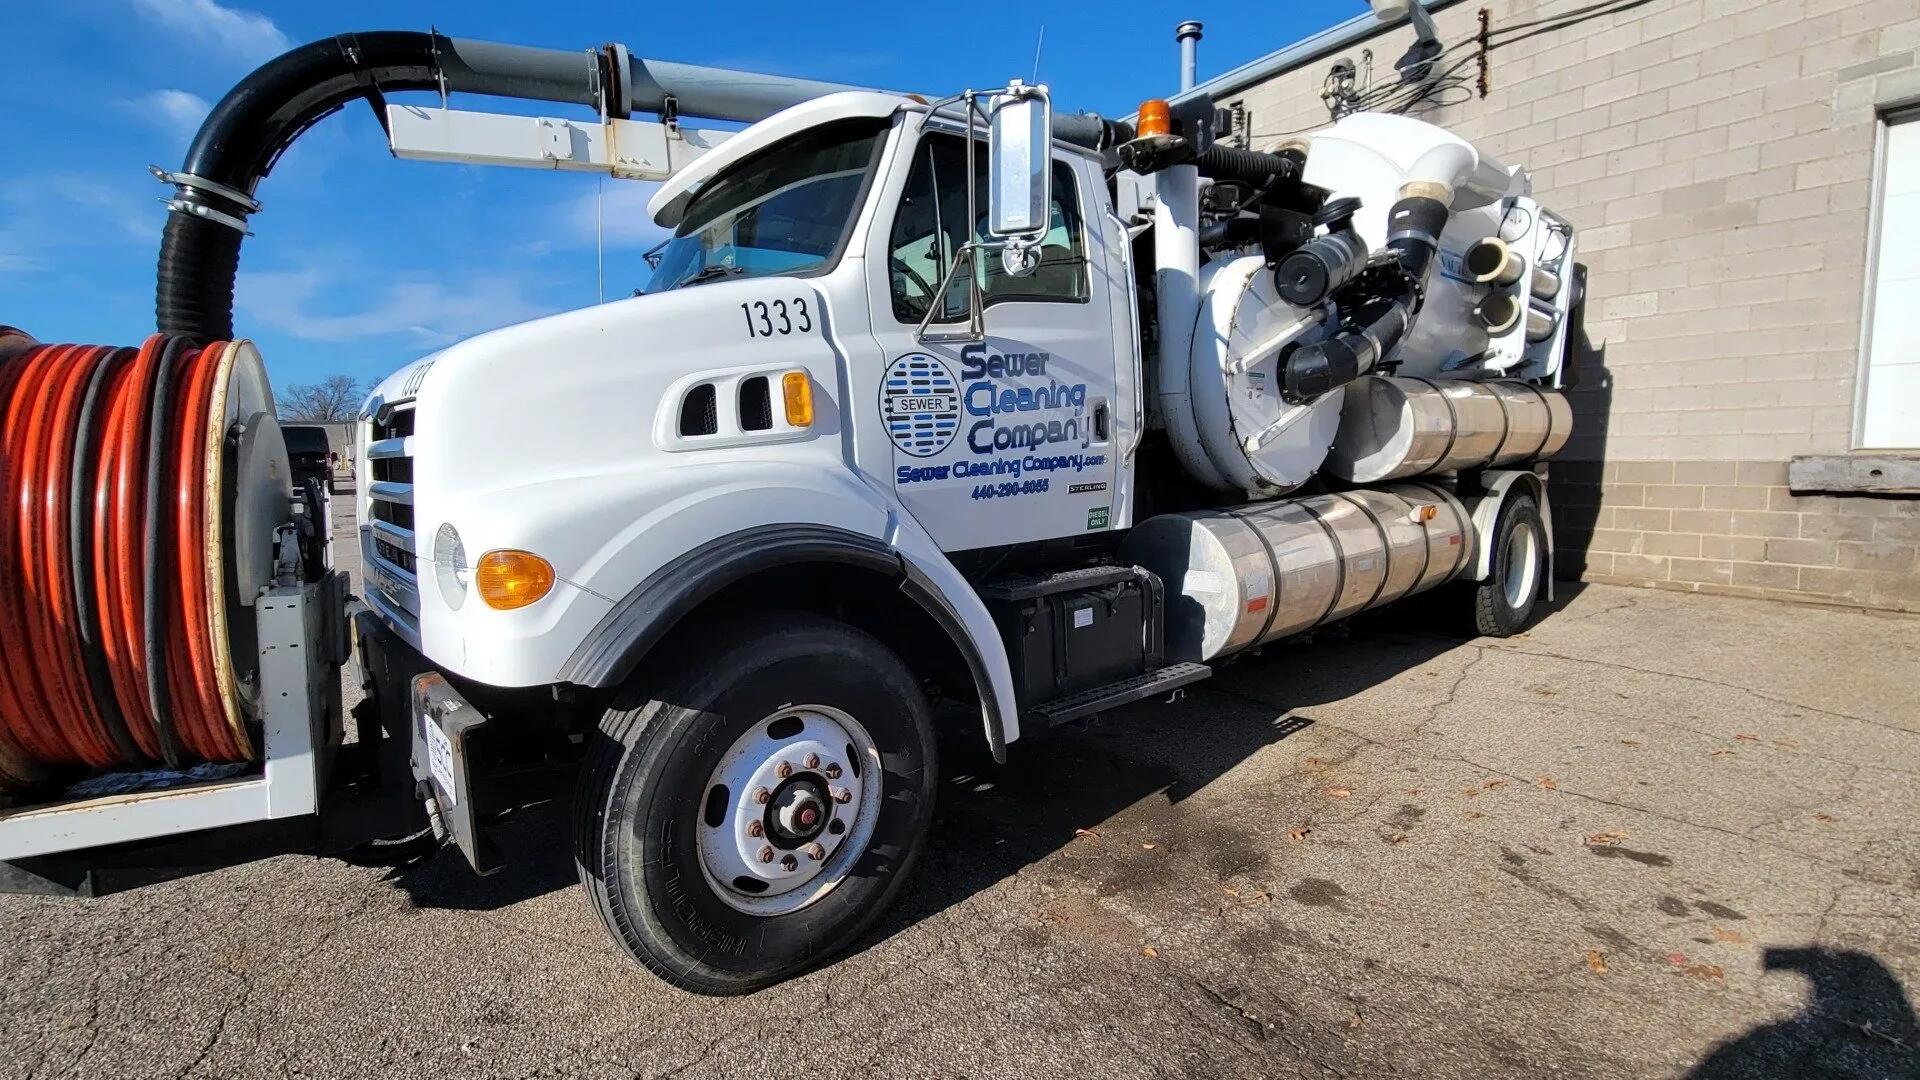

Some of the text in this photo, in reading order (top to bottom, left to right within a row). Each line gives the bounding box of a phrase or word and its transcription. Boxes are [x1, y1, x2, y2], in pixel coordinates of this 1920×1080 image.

[741, 297, 811, 337] 1333
[961, 341, 1050, 382] Sewer
[901, 398, 943, 410] SEWER
[963, 379, 1086, 417] Cleaning
[967, 418, 1090, 455] Company
[897, 465, 950, 484] Sewer
[952, 458, 1021, 478] Cleaning
[1069, 483, 1106, 492] STERLING
[1088, 510, 1109, 518] DIESEL
[1090, 518, 1106, 526] ONLY
